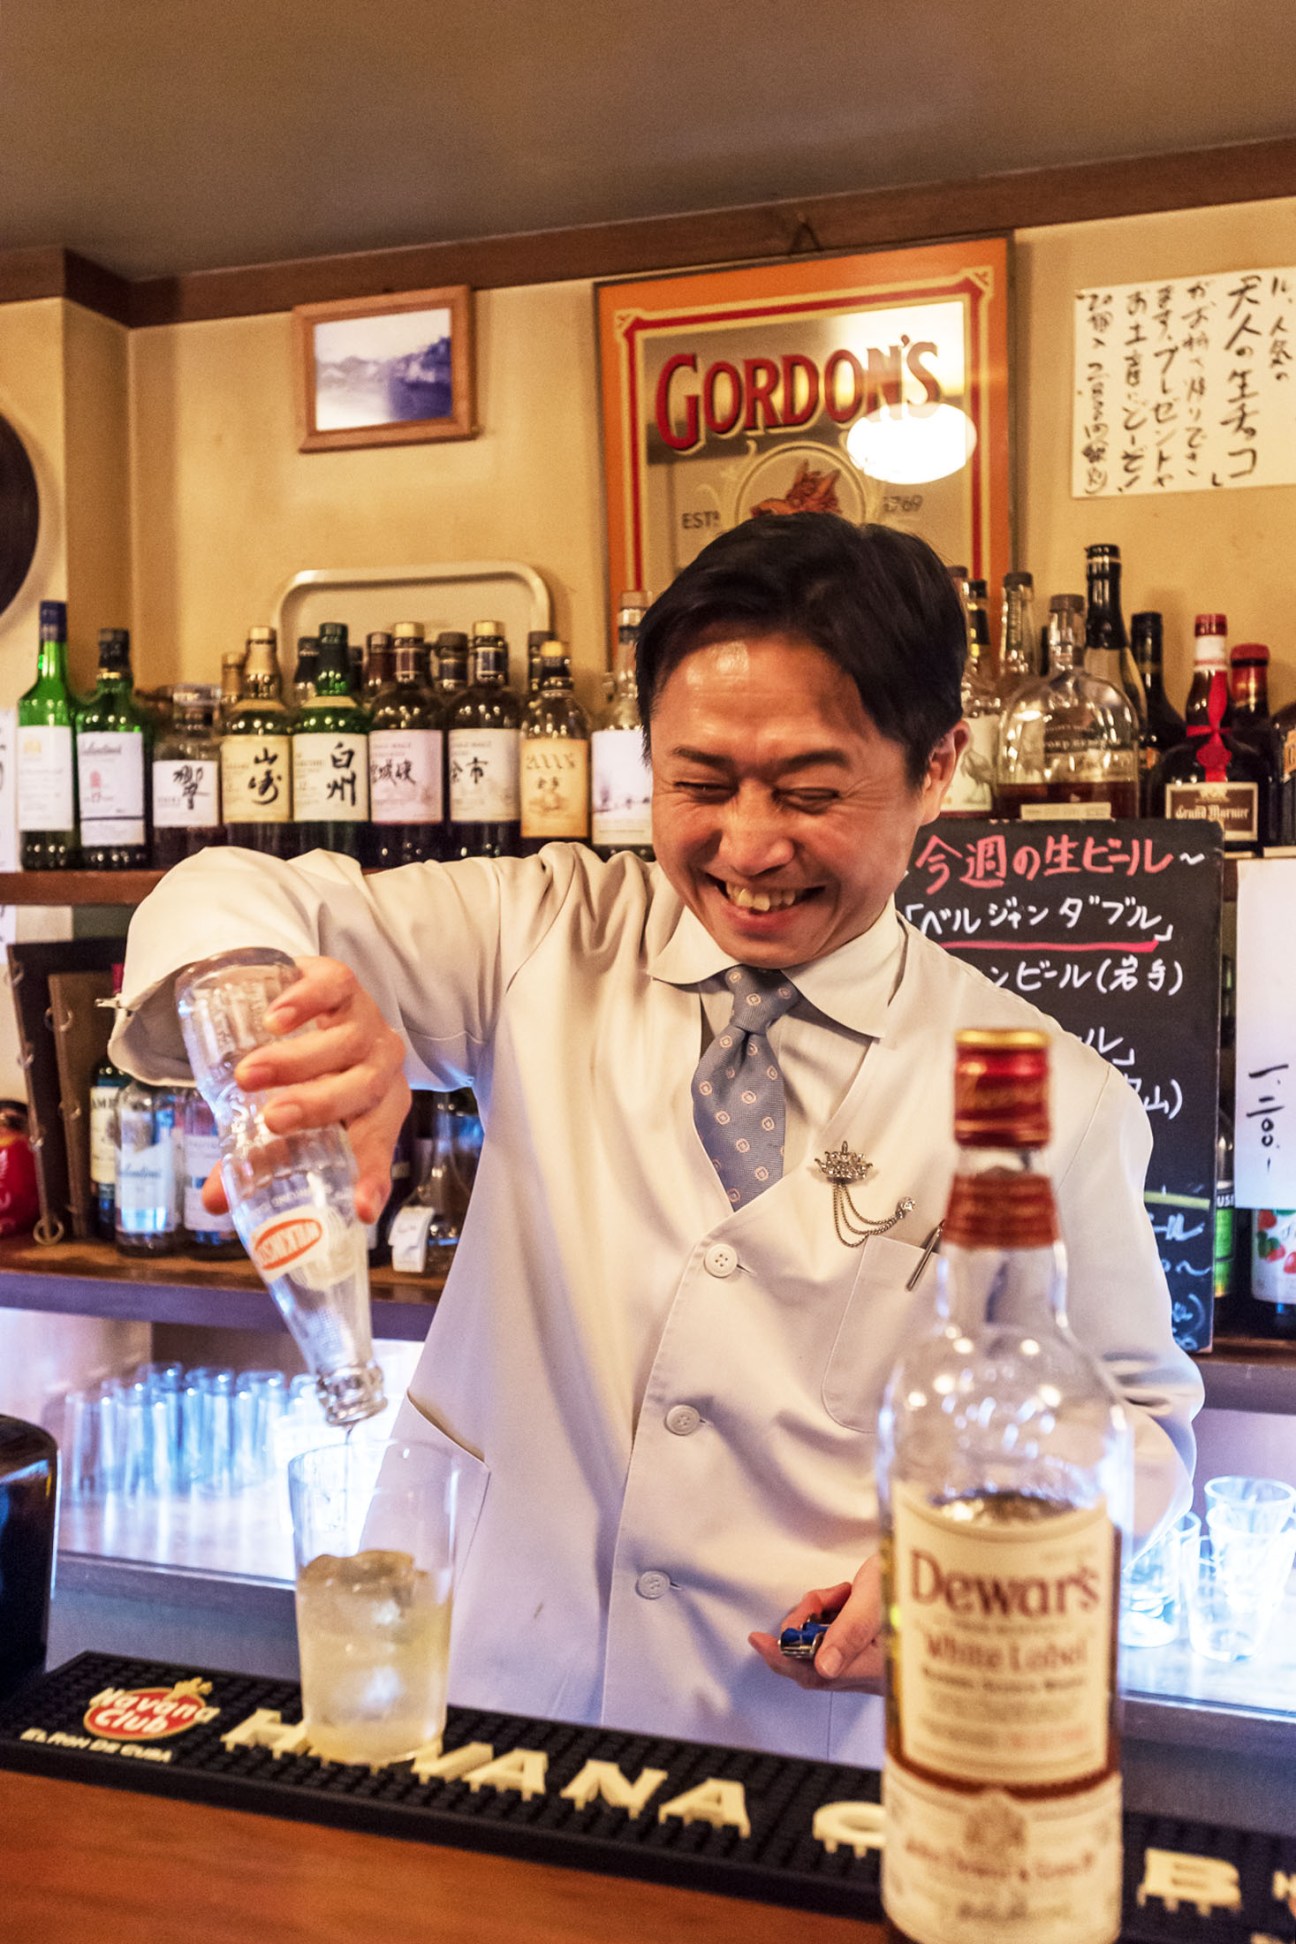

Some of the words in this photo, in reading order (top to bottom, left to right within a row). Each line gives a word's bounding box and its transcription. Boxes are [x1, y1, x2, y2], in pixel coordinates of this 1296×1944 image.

[655, 334, 942, 452] GORDON'S
[326, 741, 356, 806] 白州
[910, 1547, 1099, 1619] Dewar's
[89, 1686, 220, 1725] Havana
[94, 1708, 169, 1734] Club
